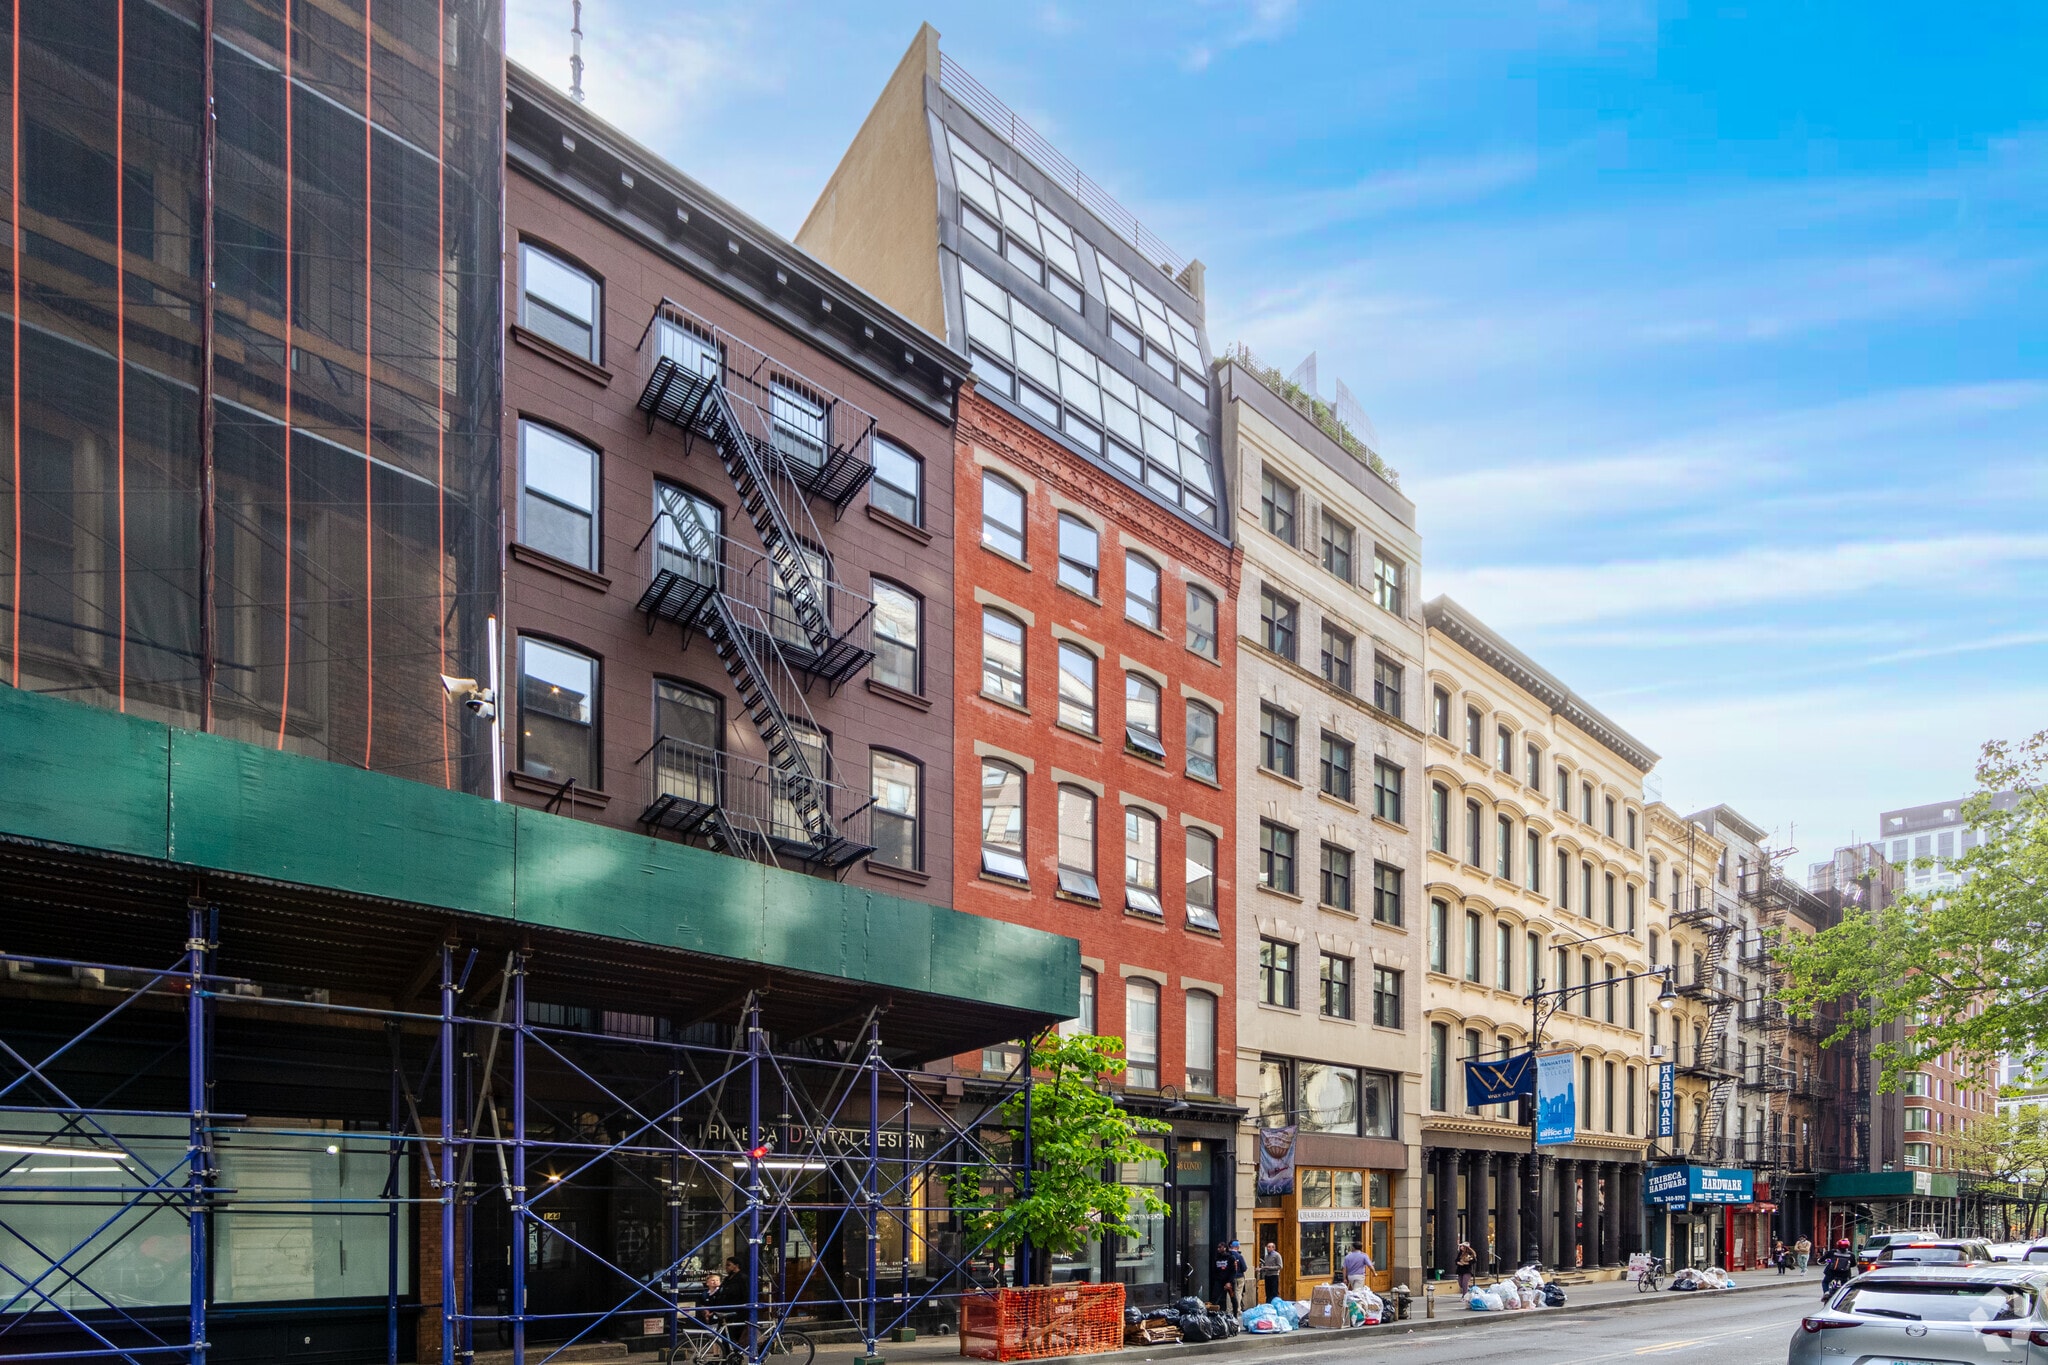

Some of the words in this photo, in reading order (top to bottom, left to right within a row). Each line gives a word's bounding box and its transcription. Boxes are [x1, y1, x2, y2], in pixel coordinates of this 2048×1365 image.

[1661, 1065, 1672, 1135] HARDWARE
[1649, 1171, 1682, 1185] TRIBECA
[1702, 1177, 1742, 1190] HARDWARE
[1649, 1178, 1687, 1193] HARDWARE
